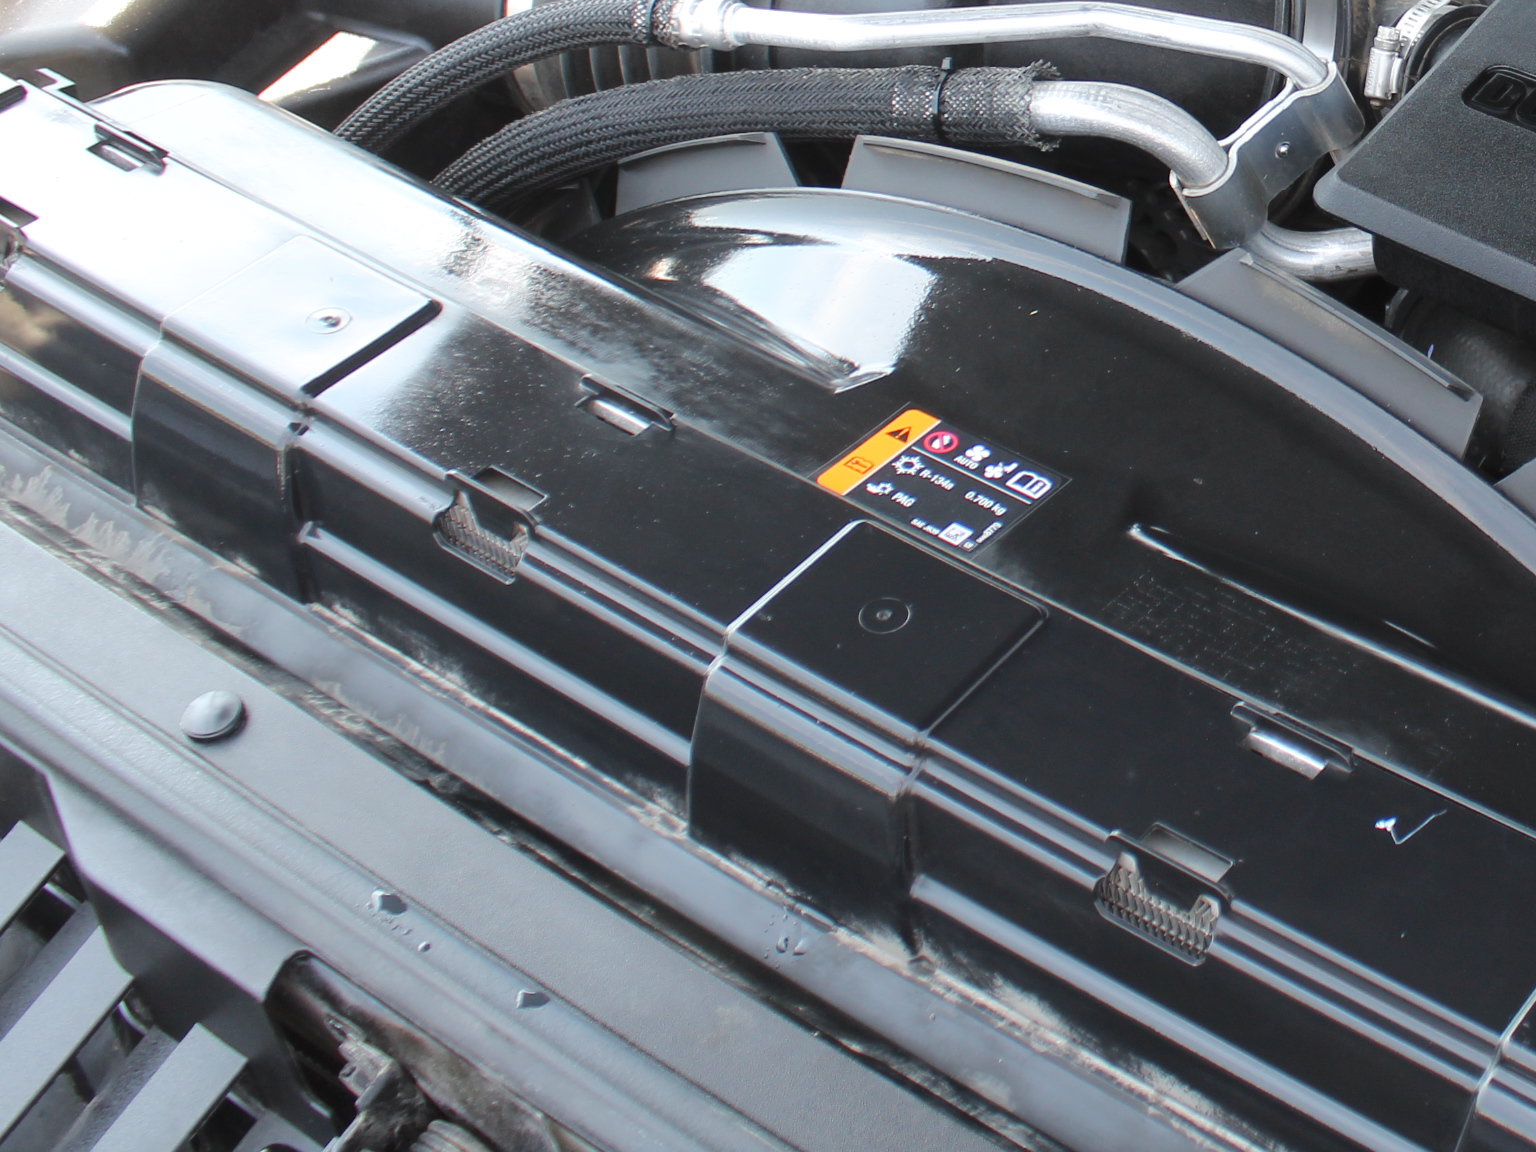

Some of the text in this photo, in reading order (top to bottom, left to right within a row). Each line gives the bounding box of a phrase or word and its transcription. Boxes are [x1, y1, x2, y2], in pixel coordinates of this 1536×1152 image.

[953, 455, 979, 470] AUTO
[919, 469, 955, 491] R-134a
[891, 491, 916, 508] PAG
[964, 490, 1007, 517] 0.700 kg
